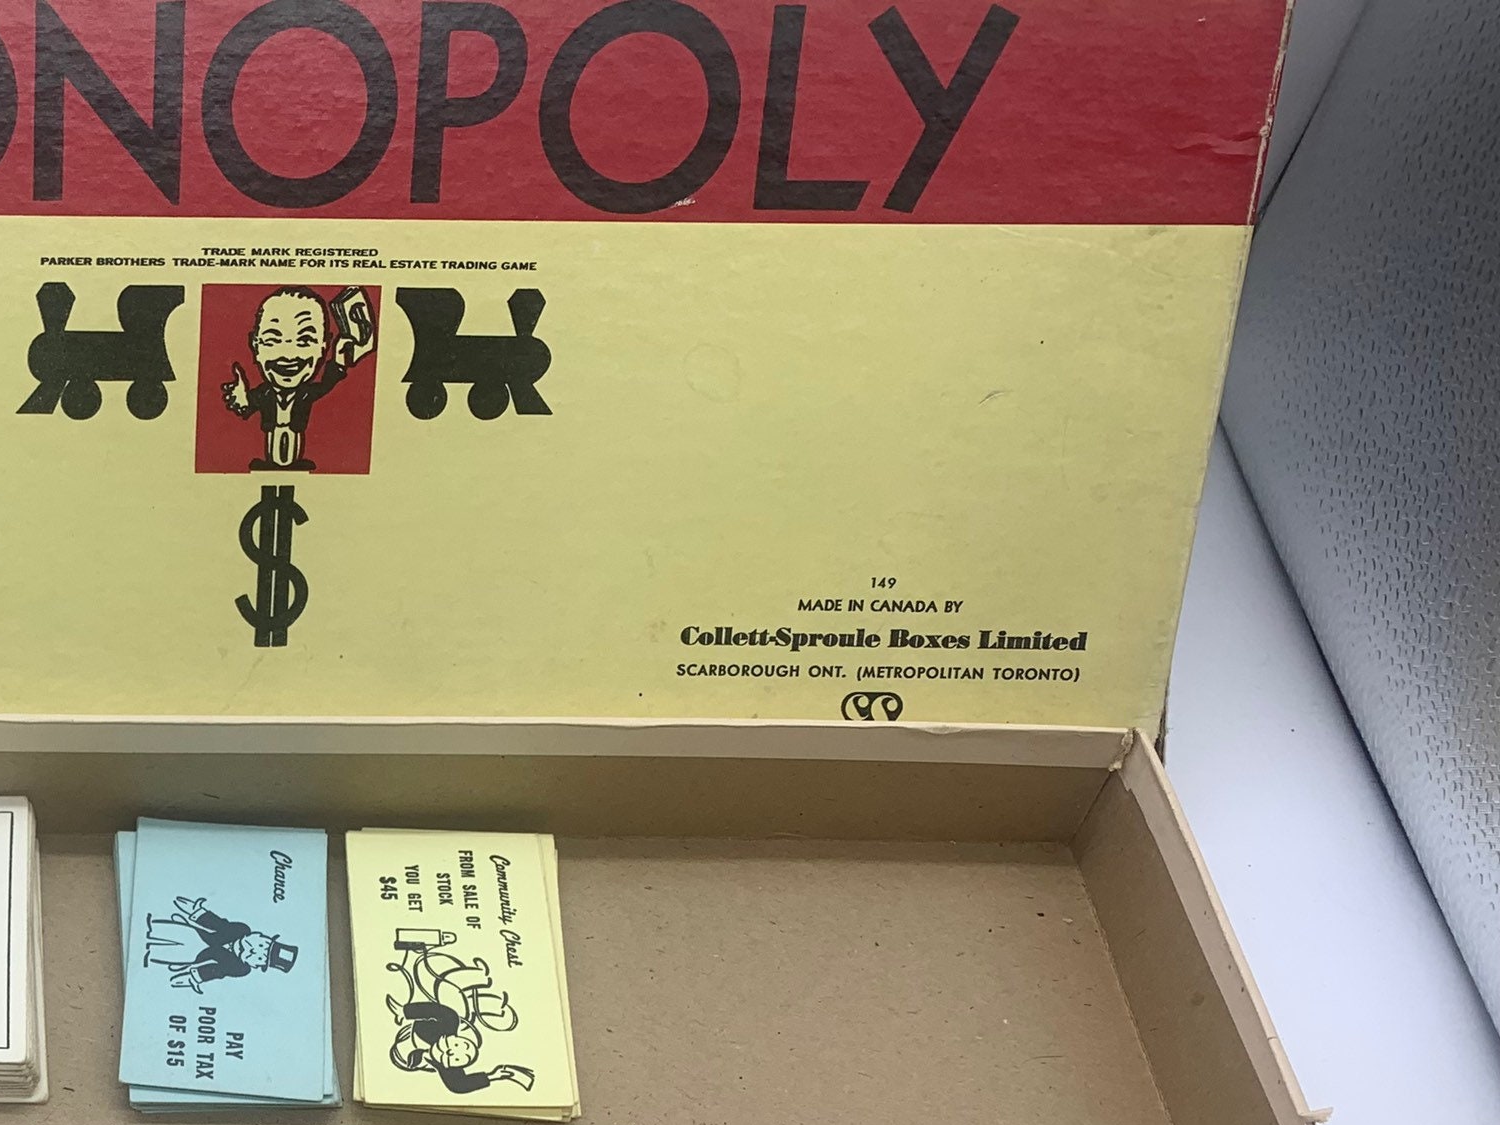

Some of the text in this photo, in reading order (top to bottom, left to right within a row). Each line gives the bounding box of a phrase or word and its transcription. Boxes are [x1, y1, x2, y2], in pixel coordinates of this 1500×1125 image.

[40, 256, 538, 271] PARKER BROTHERS TRADE-MARK NAME FOR ITS REAL ESTATE TRADING GAME
[201, 247, 379, 258] TRADE MARK REGISTERED
[870, 576, 897, 589] 149
[798, 599, 964, 613] MADE IN CANADA BY
[680, 625, 1088, 652] Collett-Sproule Boxes Limited
[676, 663, 1081, 682] SCARBOROUGH ONT. (METROPOLITAN TORONTO)
[269, 849, 293, 904] Chance
[379, 876, 399, 901] $45
[404, 865, 424, 913] YOU GET
[436, 872, 454, 906] STOCK
[458, 849, 481, 930] FROM SALE OF
[490, 854, 524, 968] Community Chest
[166, 1014, 185, 1068] OF $15
[195, 1006, 217, 1080] POOR TAX
[225, 1031, 244, 1060] PAY
